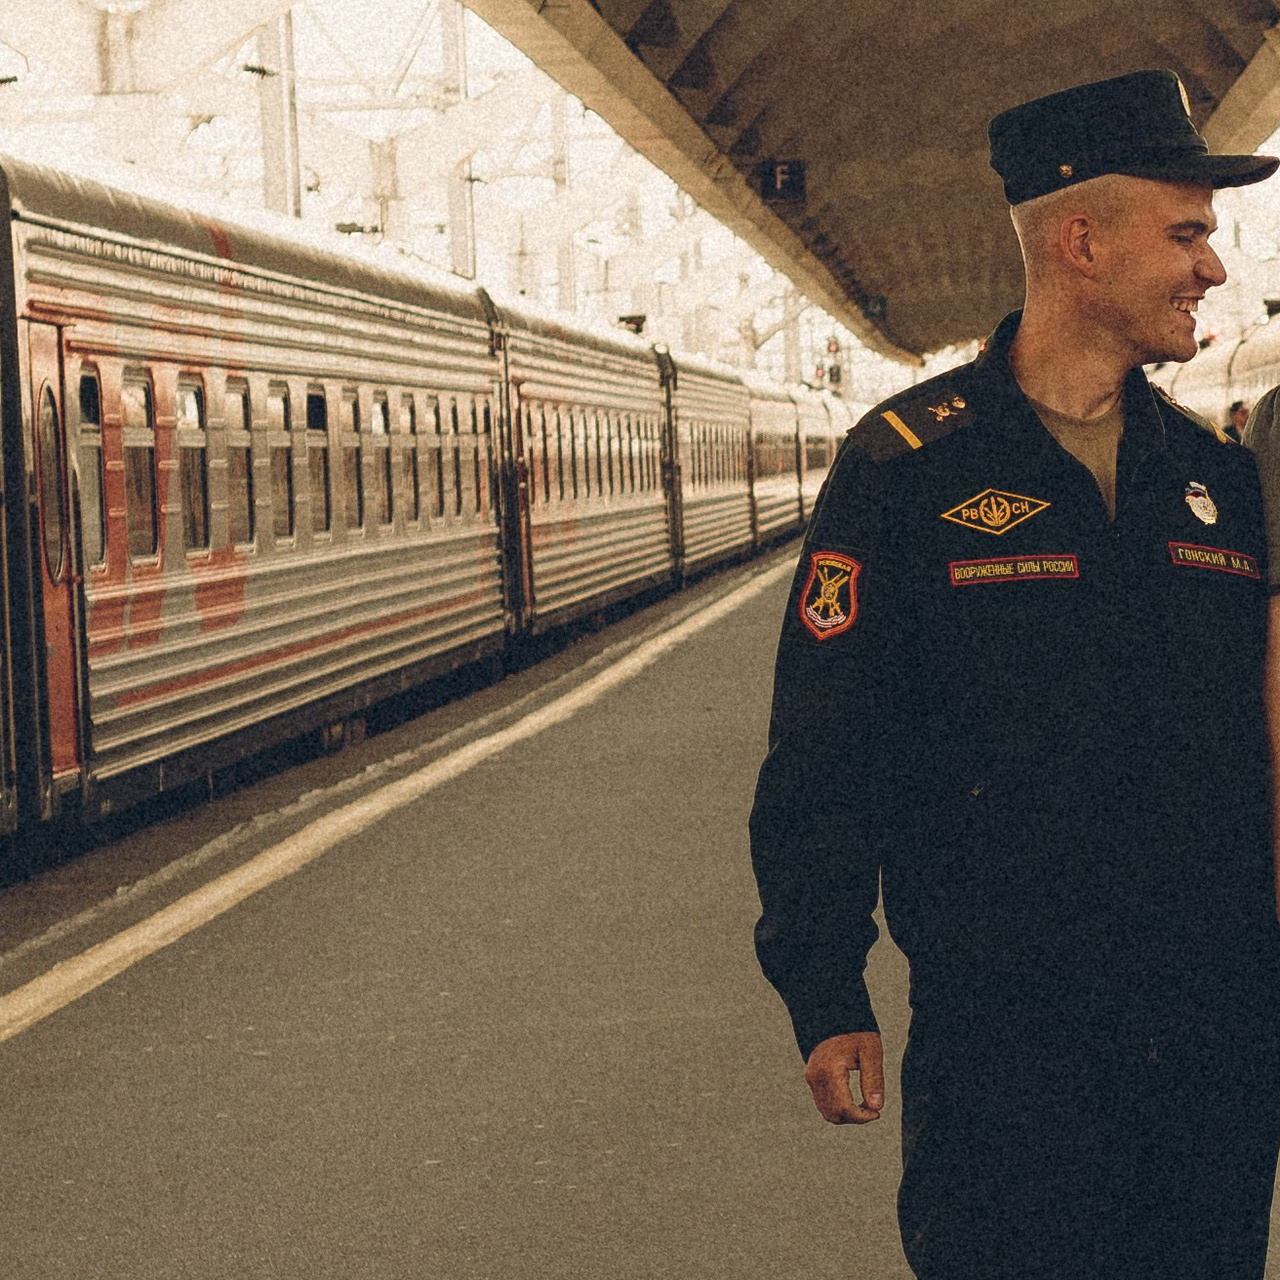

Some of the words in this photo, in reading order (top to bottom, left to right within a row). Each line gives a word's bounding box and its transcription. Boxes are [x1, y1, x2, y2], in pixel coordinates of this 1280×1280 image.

[775, 165, 789, 189] F
[954, 563, 1014, 580] ВООРУЖЕННЫЕ
[1017, 561, 1040, 573] СИЛЫ
[1043, 560, 1075, 573] РОССИИ
